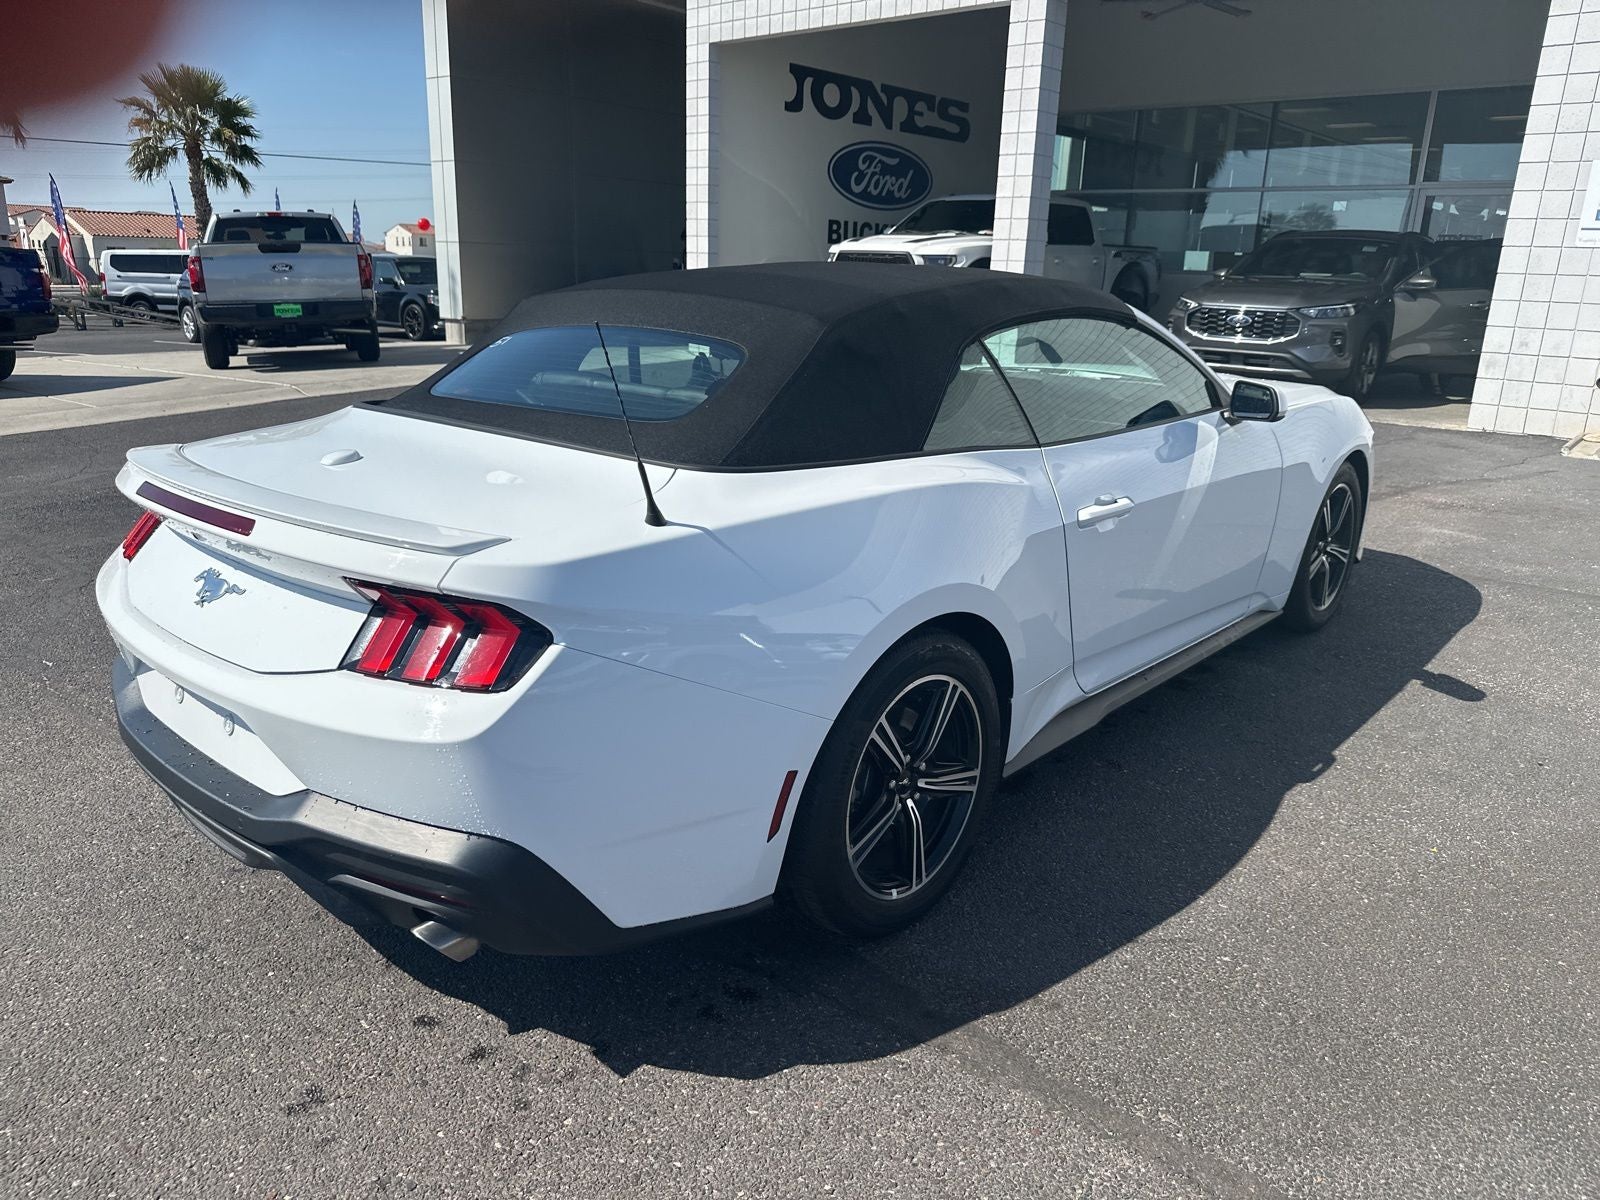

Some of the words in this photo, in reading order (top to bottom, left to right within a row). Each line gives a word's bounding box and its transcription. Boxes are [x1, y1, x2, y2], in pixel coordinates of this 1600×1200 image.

[785, 62, 970, 143] JONES
[851, 151, 914, 198] Ford
[828, 219, 893, 244] BUCK
